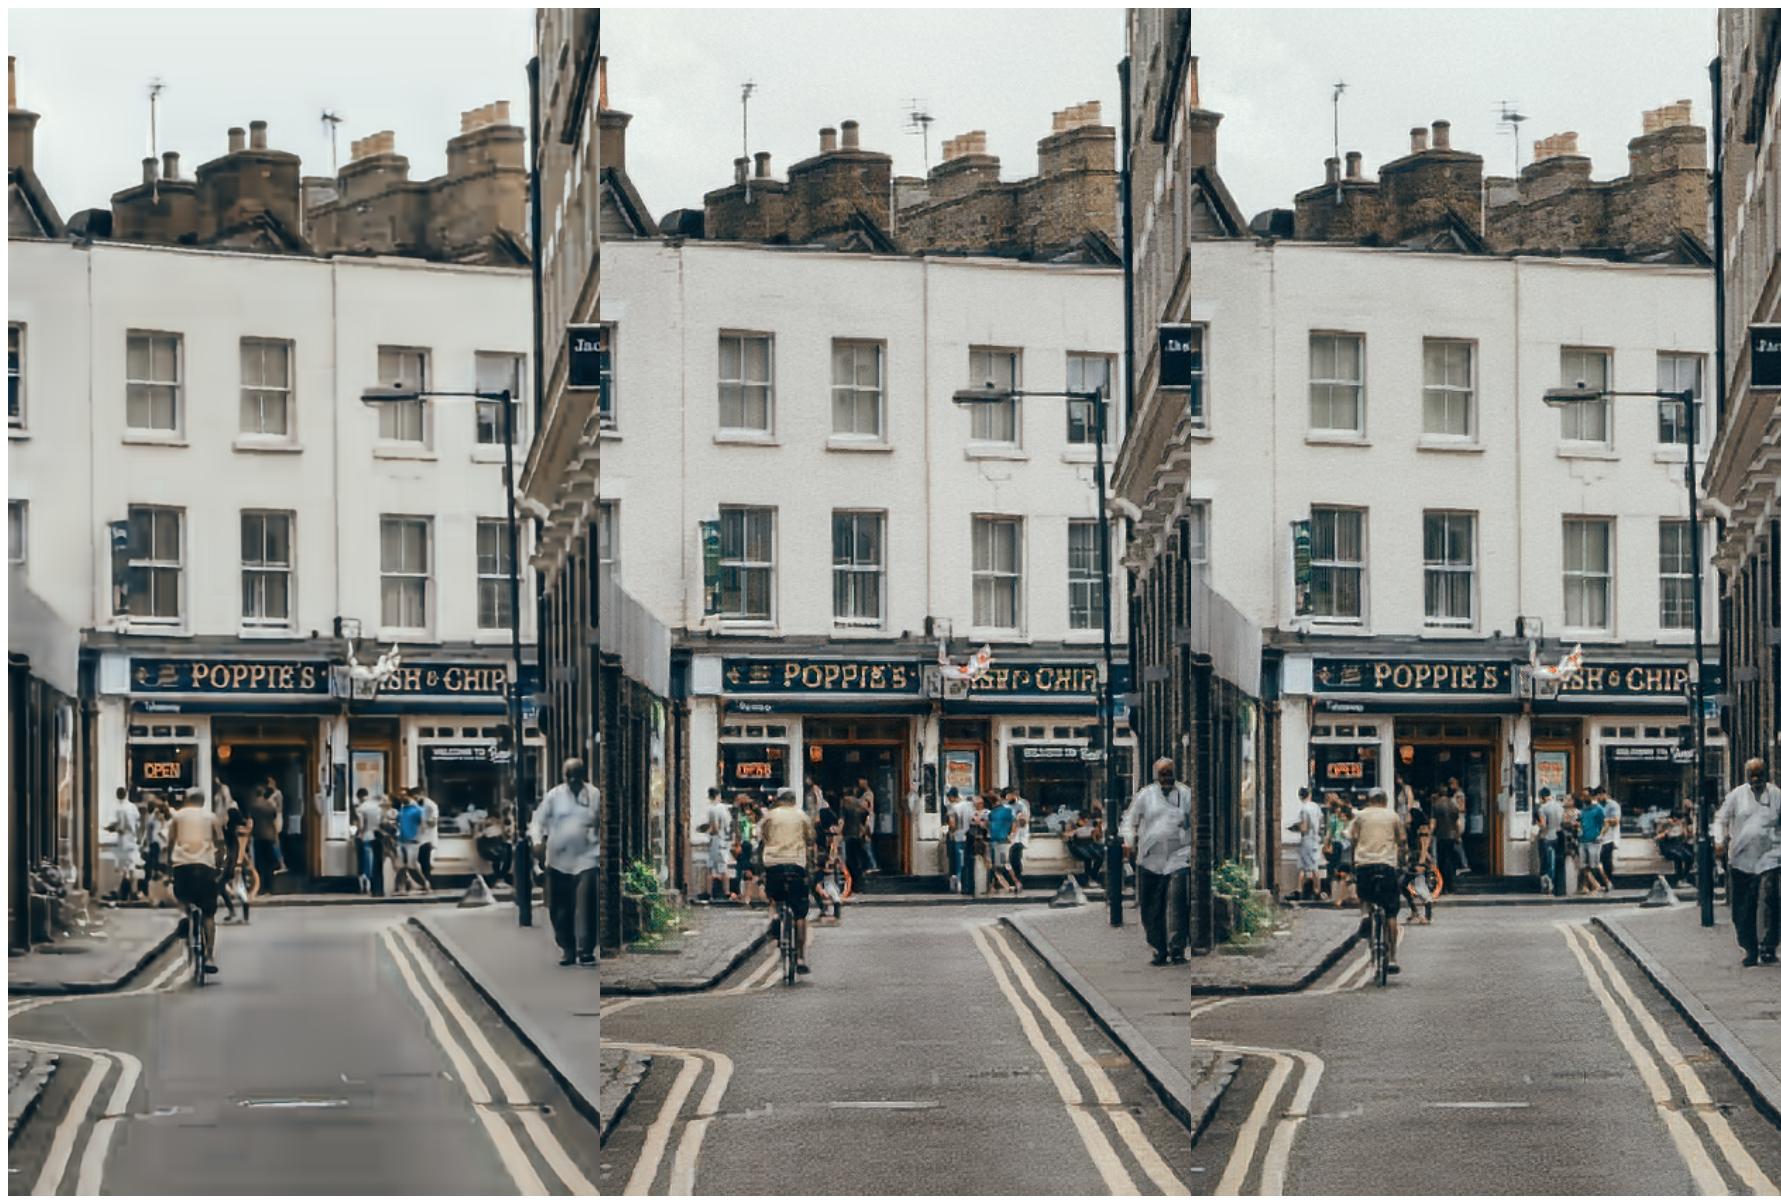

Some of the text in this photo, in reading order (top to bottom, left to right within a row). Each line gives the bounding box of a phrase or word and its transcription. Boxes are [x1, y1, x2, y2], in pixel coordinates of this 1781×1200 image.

[192, 663, 316, 688] POPPIE'S
[443, 667, 506, 691] CHIP
[1626, 667, 1688, 691] CHIP
